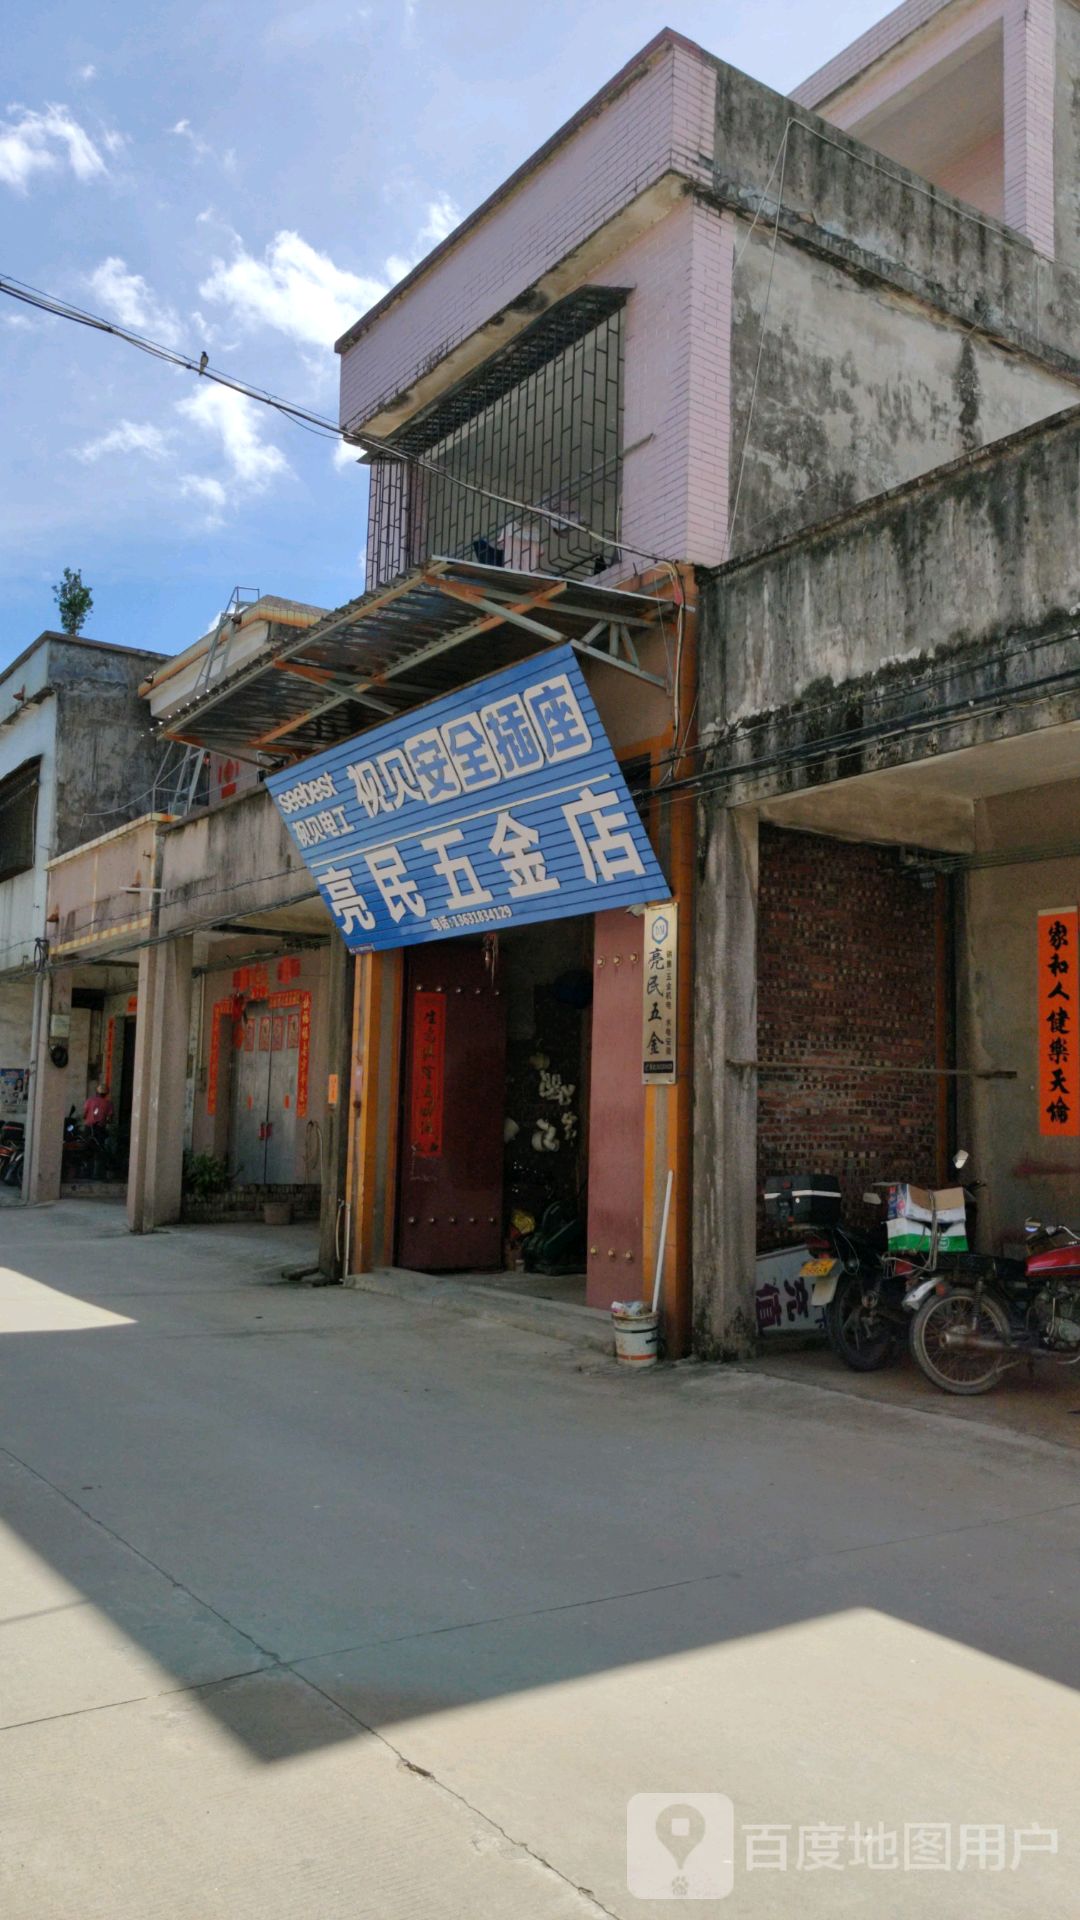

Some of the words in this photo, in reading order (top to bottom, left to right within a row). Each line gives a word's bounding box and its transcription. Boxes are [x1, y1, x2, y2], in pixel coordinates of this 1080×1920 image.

[279, 771, 338, 814] seebest
[346, 675, 592, 818] 视贝安全插座
[292, 805, 355, 847] 视贝电工
[316, 787, 646, 935] 亮民五金店
[646, 947, 665, 1056] 亮民五金
[1046, 920, 1070, 1125] 家和人健樂天倫
